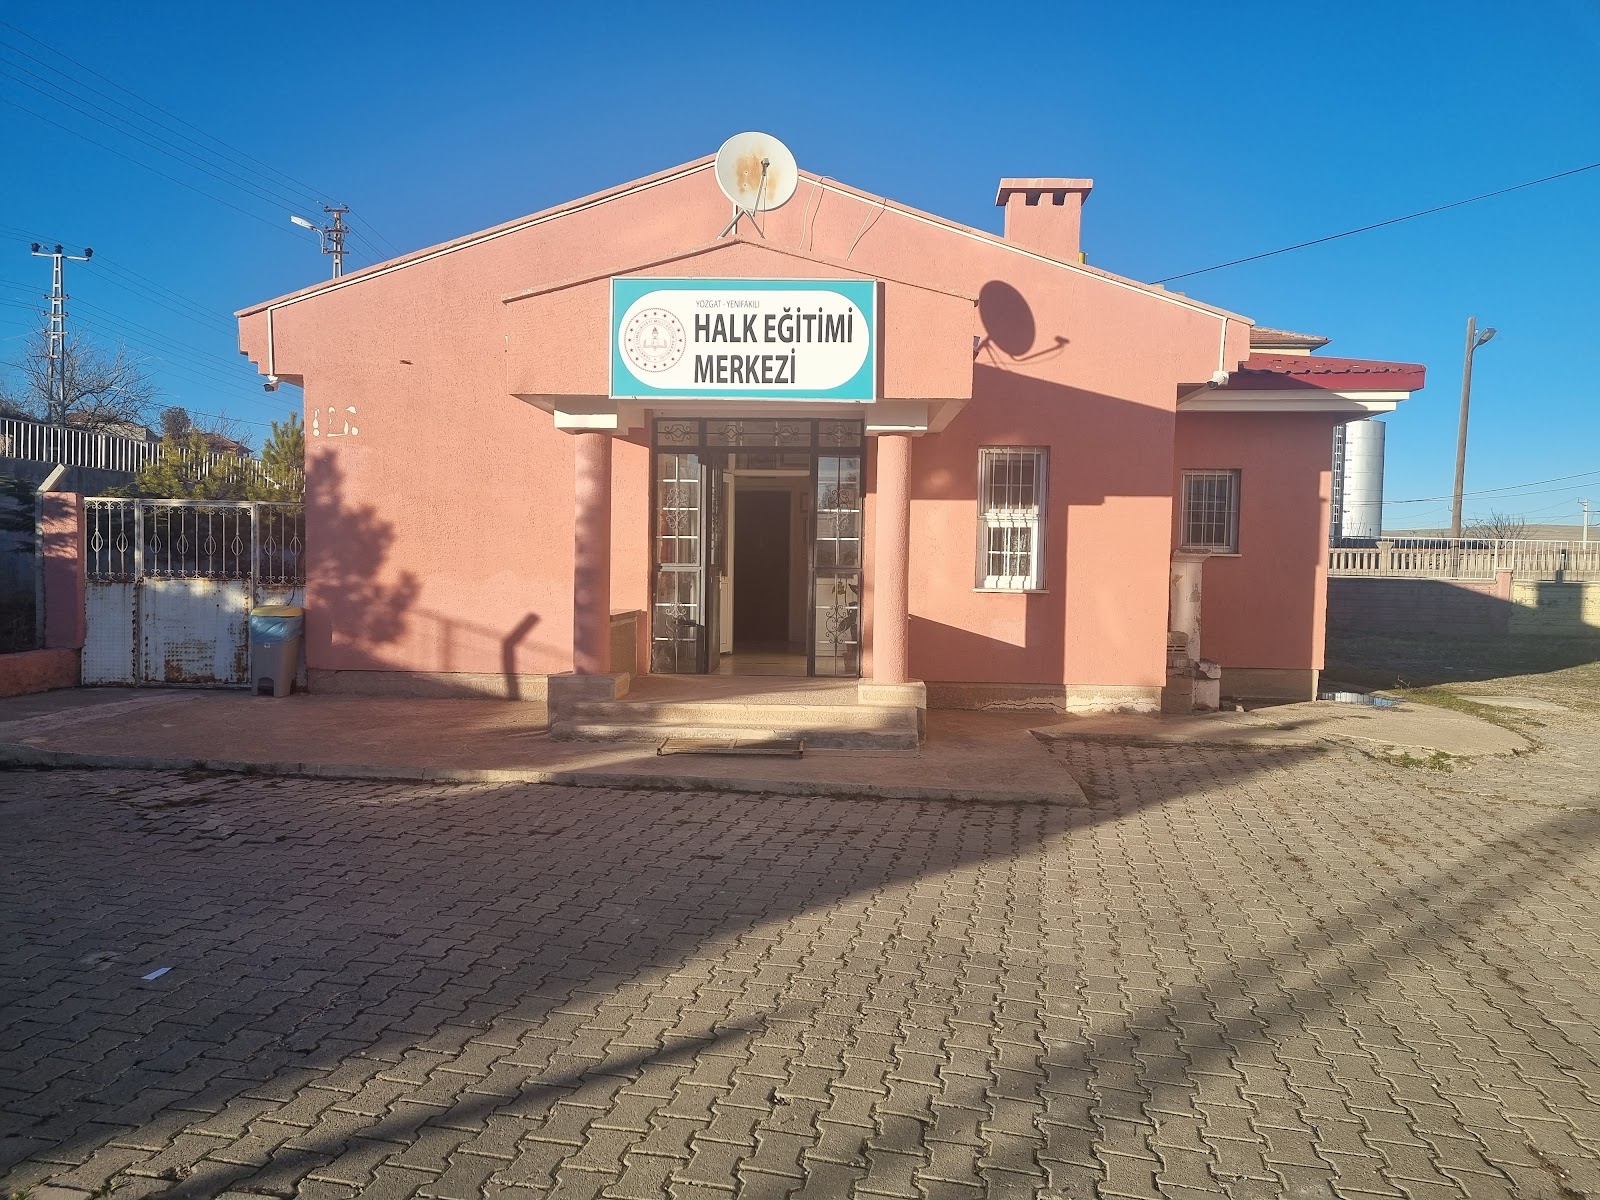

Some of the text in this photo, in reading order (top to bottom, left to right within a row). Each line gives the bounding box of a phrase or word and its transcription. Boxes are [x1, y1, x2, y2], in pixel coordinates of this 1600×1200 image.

[695, 299, 722, 309] YOZGAT
[694, 314, 758, 343] HALK
[764, 307, 853, 343] EĞİTİMİ
[694, 348, 796, 384] MERKEZİ
